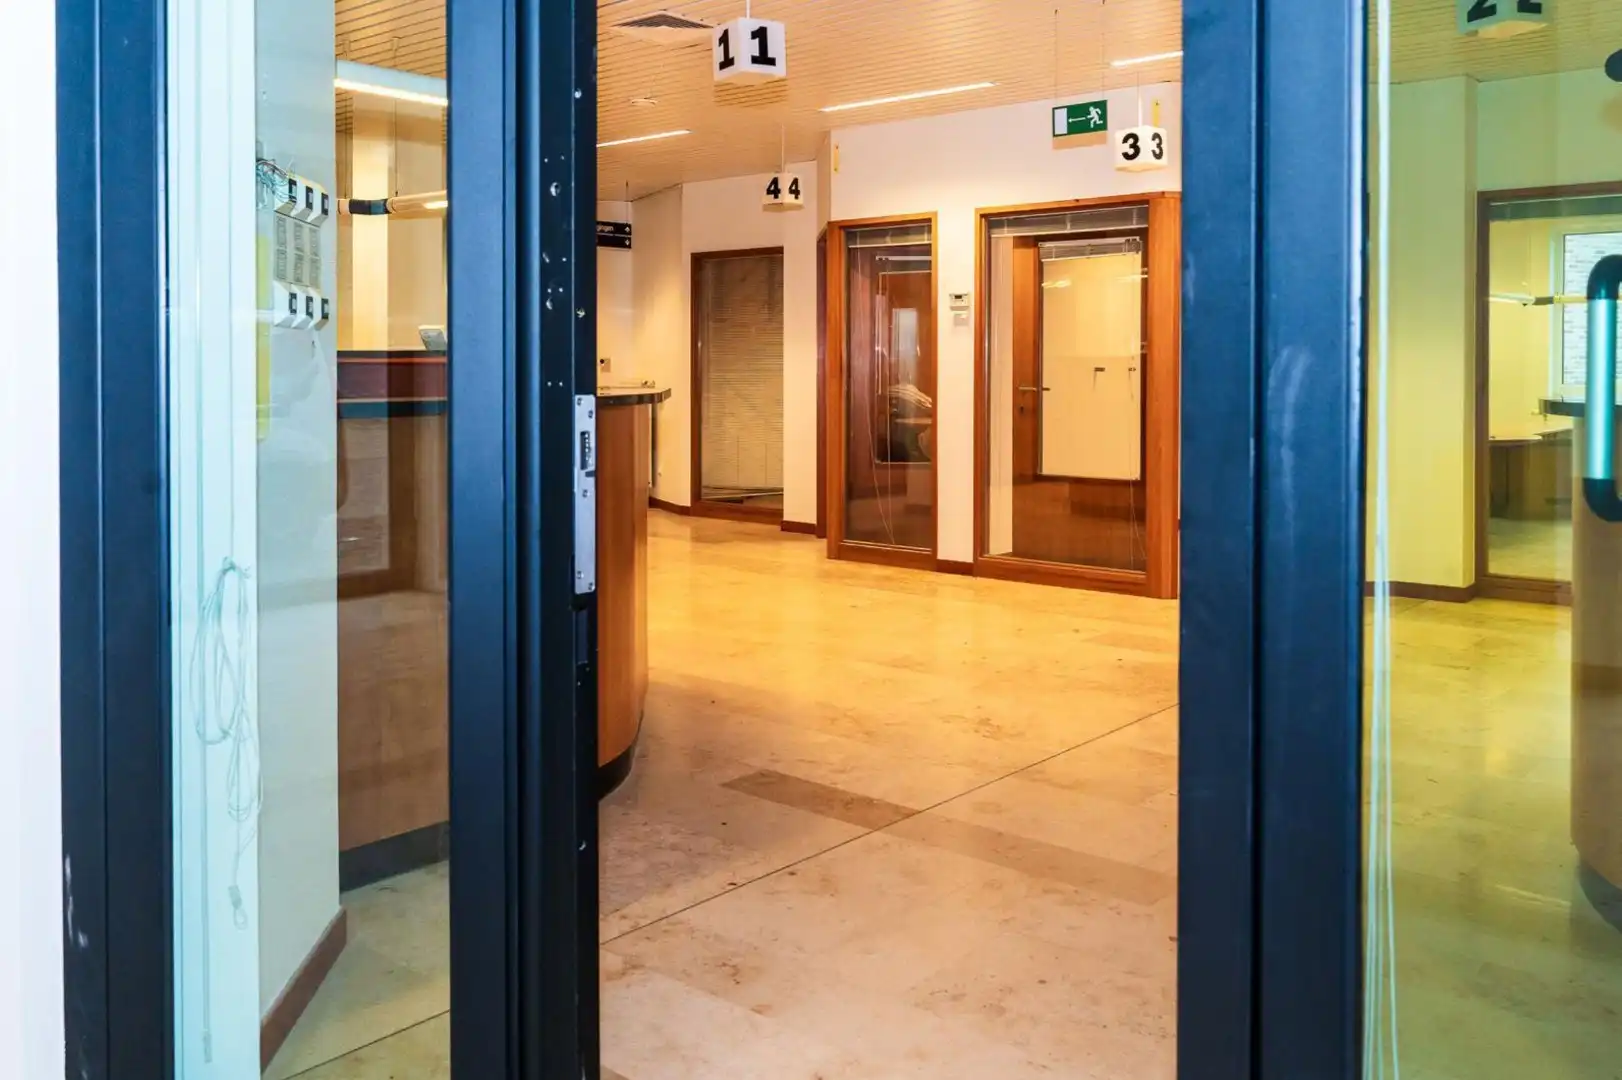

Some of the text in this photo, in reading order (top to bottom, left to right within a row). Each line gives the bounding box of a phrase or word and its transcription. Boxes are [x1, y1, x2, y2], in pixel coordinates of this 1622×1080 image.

[718, 28, 735, 71] 1
[750, 26, 776, 67] 1
[1121, 133, 1140, 161] 3
[1151, 132, 1164, 160] 3
[766, 176, 781, 199] 4
[788, 177, 801, 200] 4
